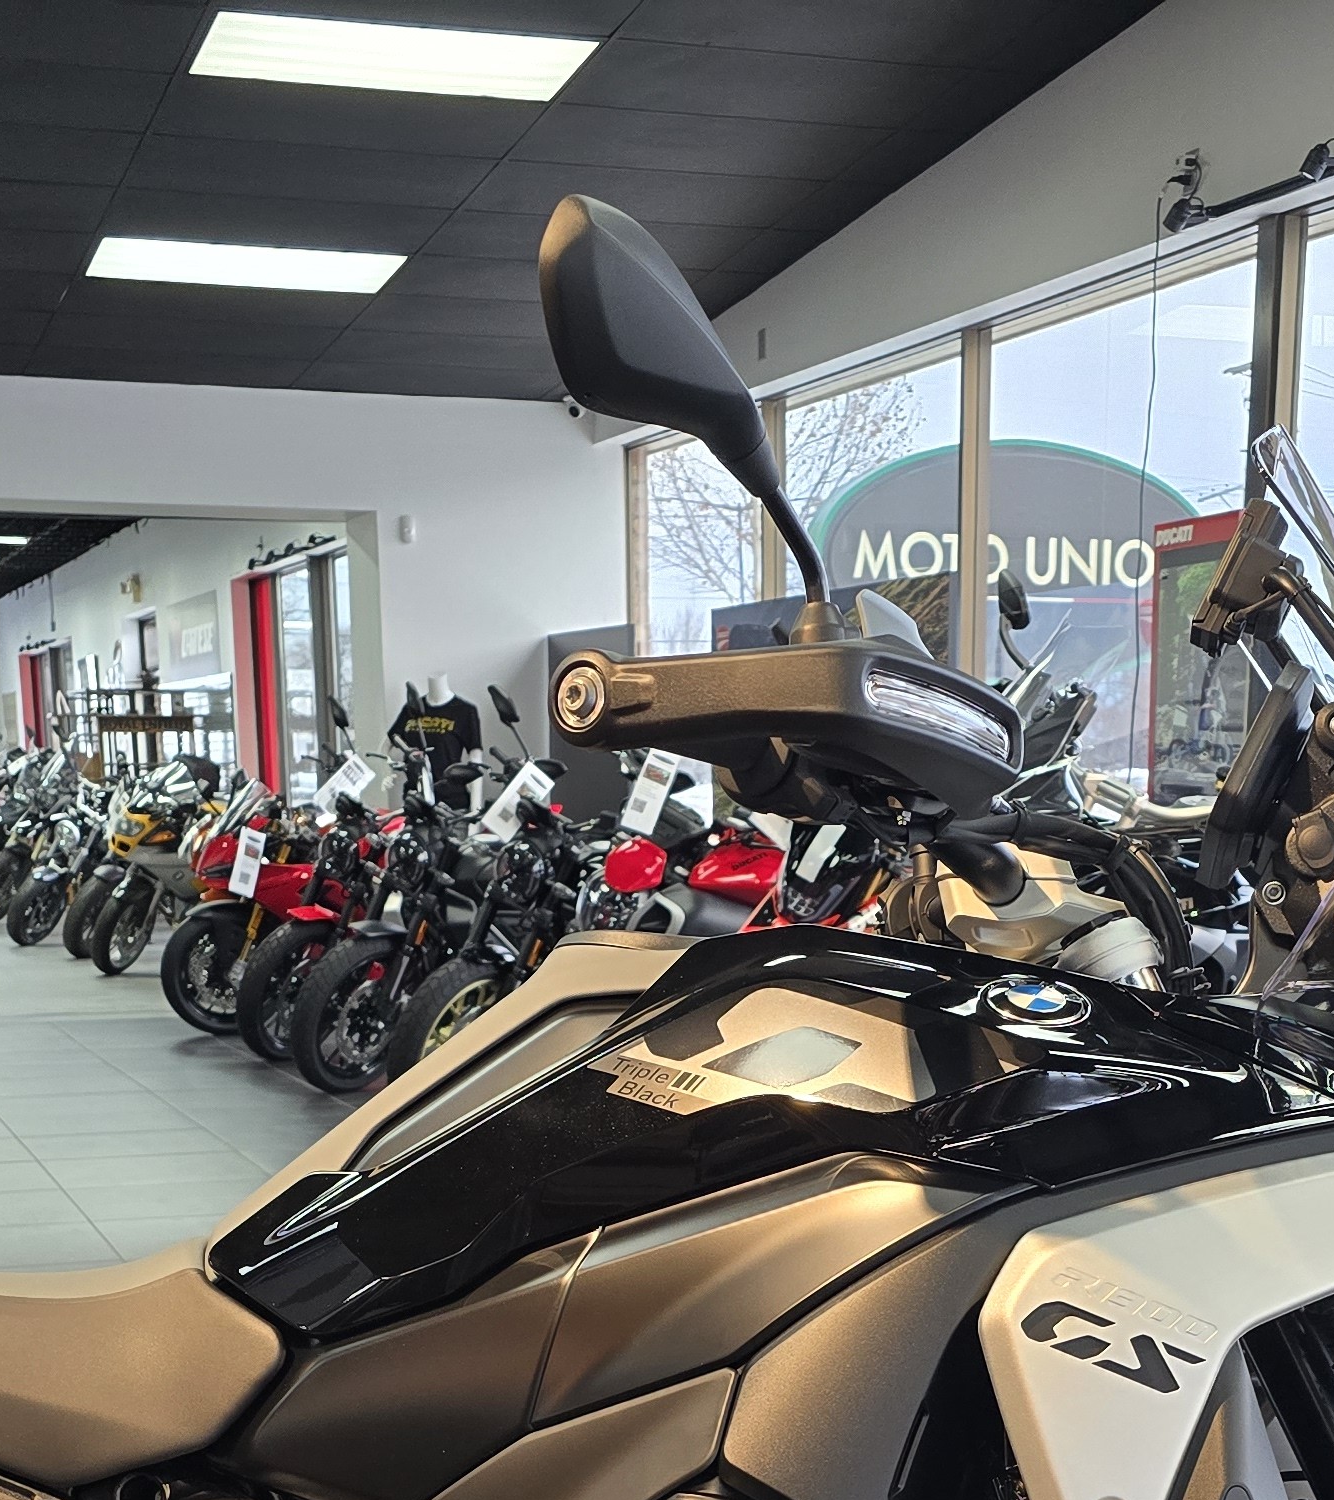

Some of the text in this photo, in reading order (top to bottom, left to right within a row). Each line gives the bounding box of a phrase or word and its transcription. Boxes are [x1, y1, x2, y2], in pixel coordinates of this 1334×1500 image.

[1155, 525, 1194, 547] DUCATI
[1025, 536, 1155, 588] UNIO
[611, 1056, 670, 1086] Triple
[618, 1079, 680, 1110] Black
[1020, 1300, 1207, 1394] GS
